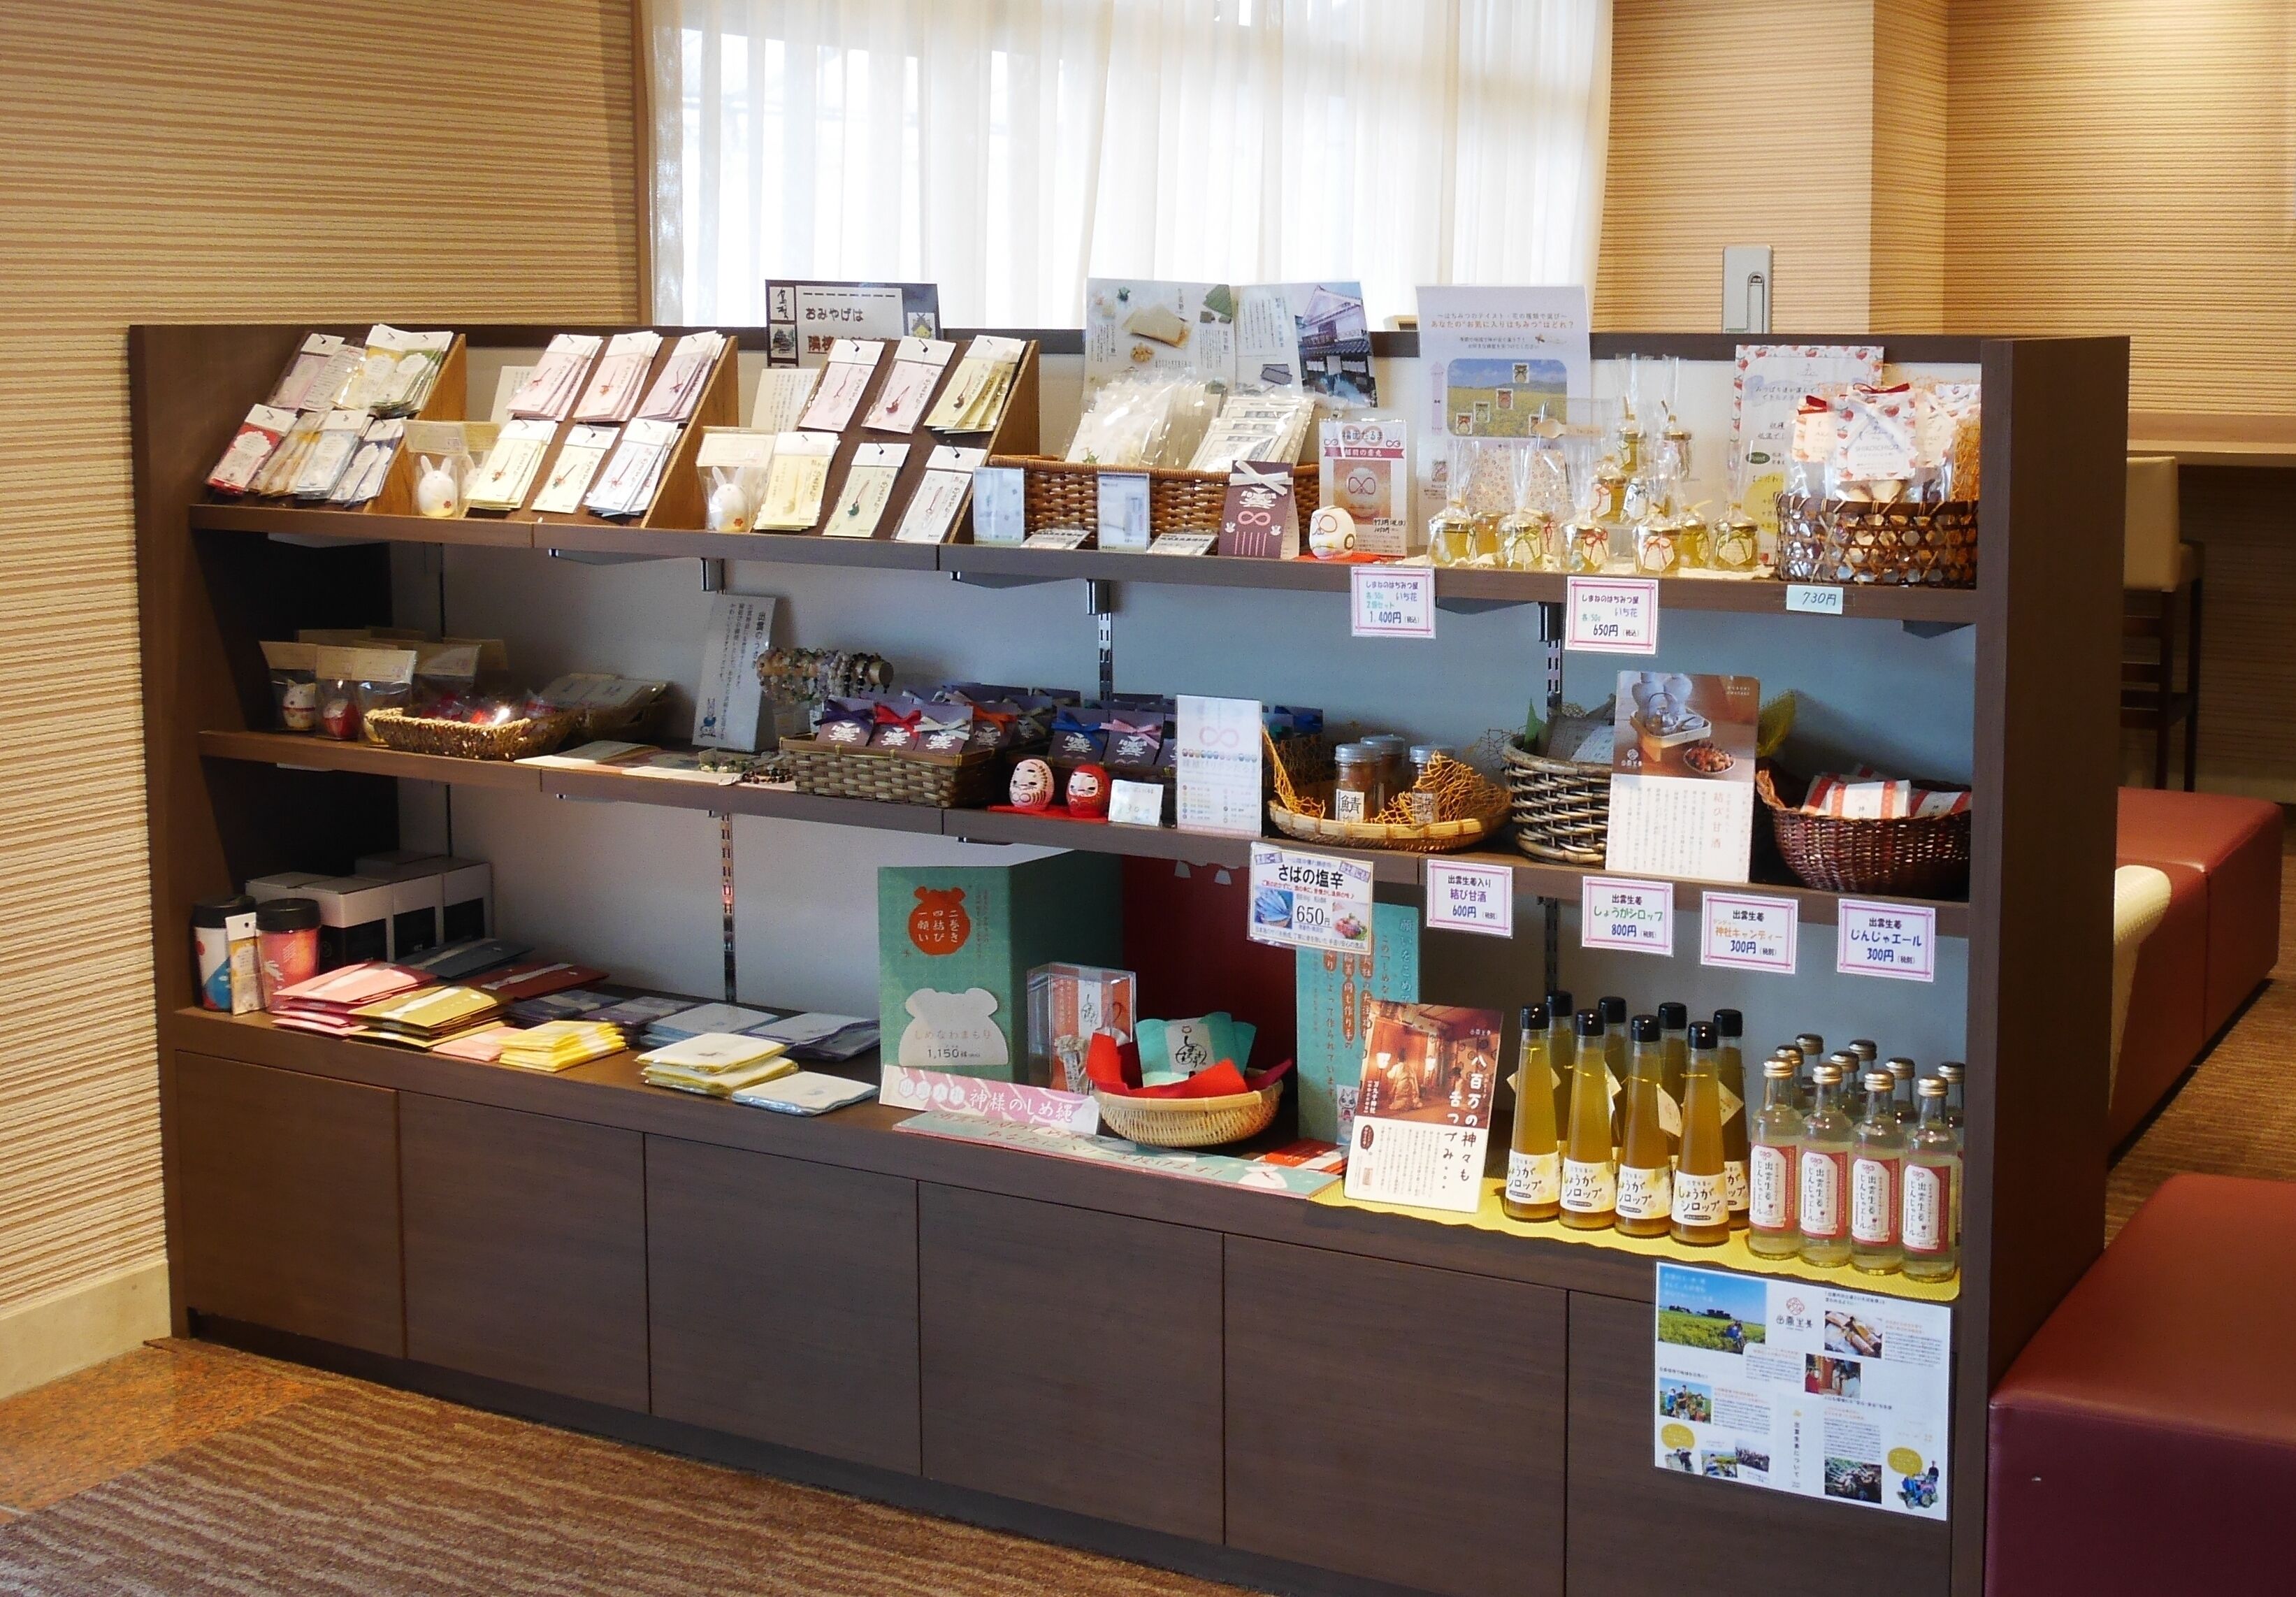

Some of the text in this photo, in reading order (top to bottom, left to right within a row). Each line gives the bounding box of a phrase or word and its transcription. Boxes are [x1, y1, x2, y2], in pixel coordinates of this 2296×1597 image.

[805, 307, 864, 322] おみやげは
[1365, 581, 1420, 590] しまねのはちみつ屋
[1581, 594, 1640, 605] しまねのはちみつ屋
[1802, 591, 1837, 607] 730円
[1593, 624, 1619, 637] 650円
[1277, 864, 1344, 890] さばの塩辛
[1447, 874, 1492, 888] 出雲生姜入り
[1450, 888, 1487, 902] 結び甘酒
[1611, 894, 1643, 906] 出雲生姜
[1296, 904, 1331, 926] 650円
[1452, 905, 1477, 918] 600円
[1732, 910, 1765, 922] 出雲生姜
[916, 910, 930, 943] 一願い
[932, 909, 945, 943] 四結び
[948, 909, 960, 944] 二巻き
[1610, 924, 1638, 937] 800円
[1868, 917, 1902, 930] 出雲生姜
[1715, 926, 1783, 941] 神社キャンディー
[1850, 928, 1923, 948] じんじゃエール
[1729, 940, 1757, 954] 300円
[1866, 948, 1895, 963] 300円
[914, 1028, 992, 1041] しめなわまもり
[969, 1090, 1075, 1124] 神様のしめ縄
[1459, 1053, 1488, 1183] 八百万の神々も
[1792, 1421, 1802, 1478] 出雲生姜について
